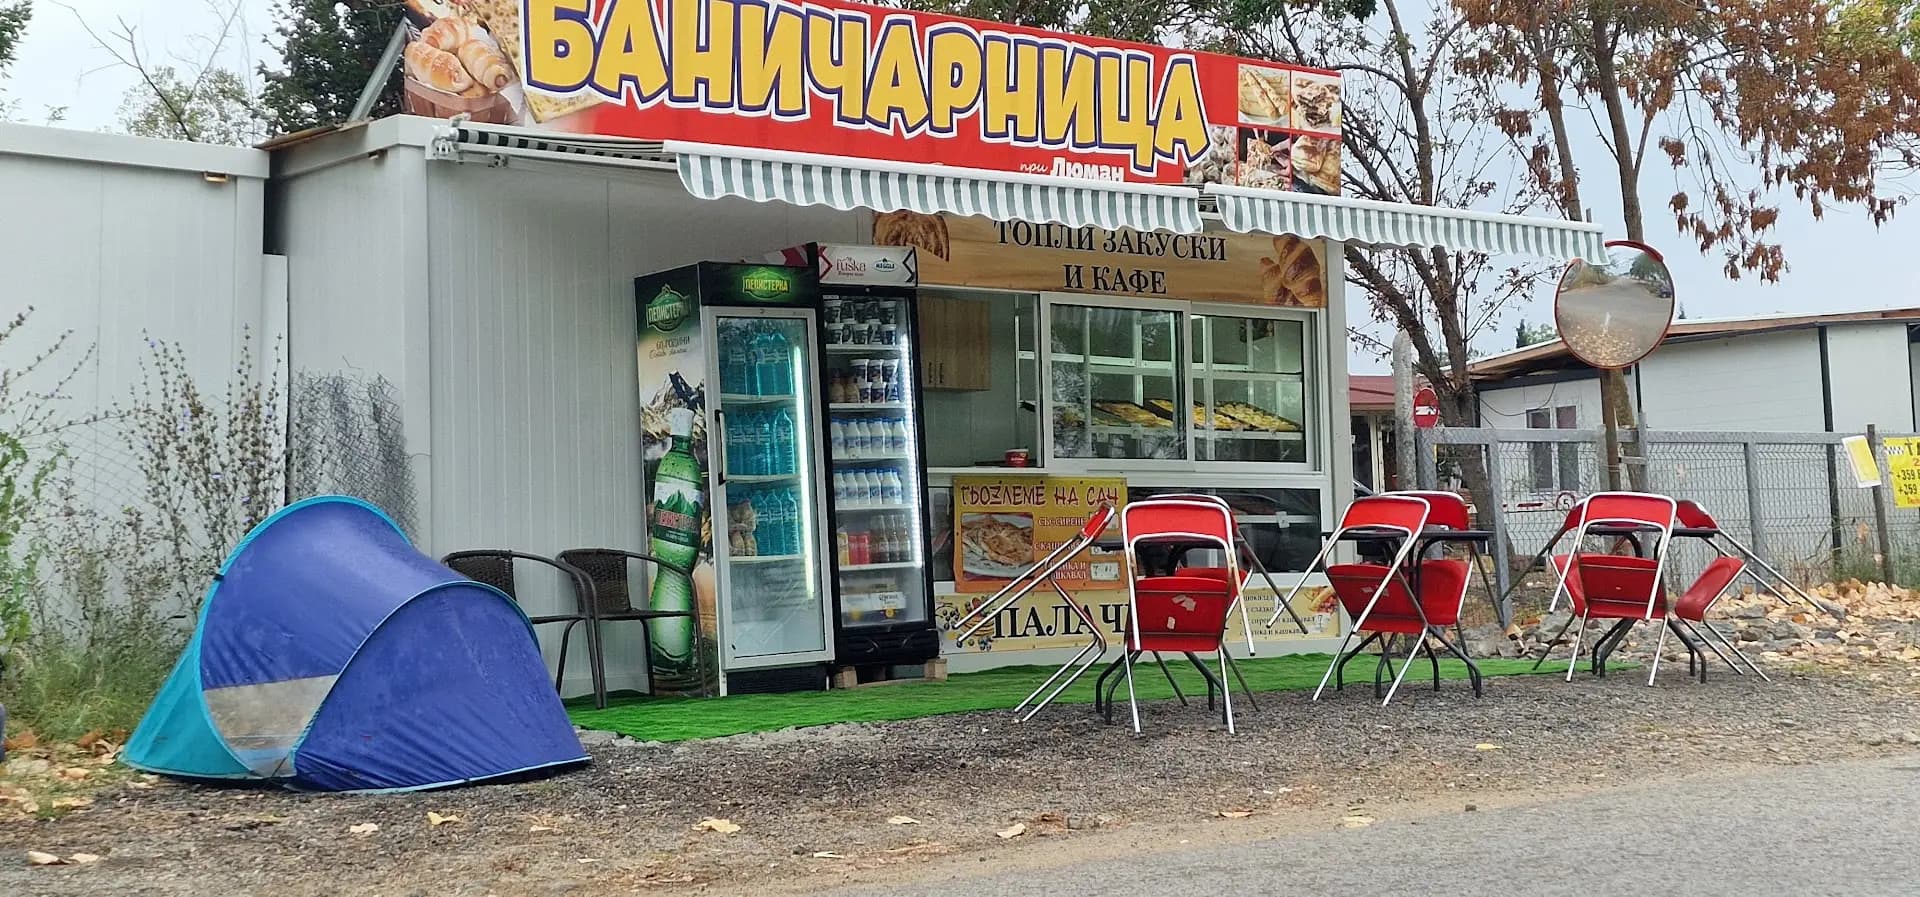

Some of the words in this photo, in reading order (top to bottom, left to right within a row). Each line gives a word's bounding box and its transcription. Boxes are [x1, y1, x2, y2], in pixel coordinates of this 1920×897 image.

[523, 0, 1210, 172] БАНИЧАРНИЦА
[1019, 161, 1048, 173] при
[1050, 157, 1124, 182] Люман
[994, 221, 1097, 251] ТОПЛИ
[1103, 231, 1227, 261] ЗАКУСКИ
[1063, 264, 1083, 289] И
[1091, 266, 1167, 294] КАФЕ
[1054, 486, 1080, 506] НА
[1086, 486, 1119, 506] САЧ
[992, 604, 1130, 639] ПАЛАЧ
